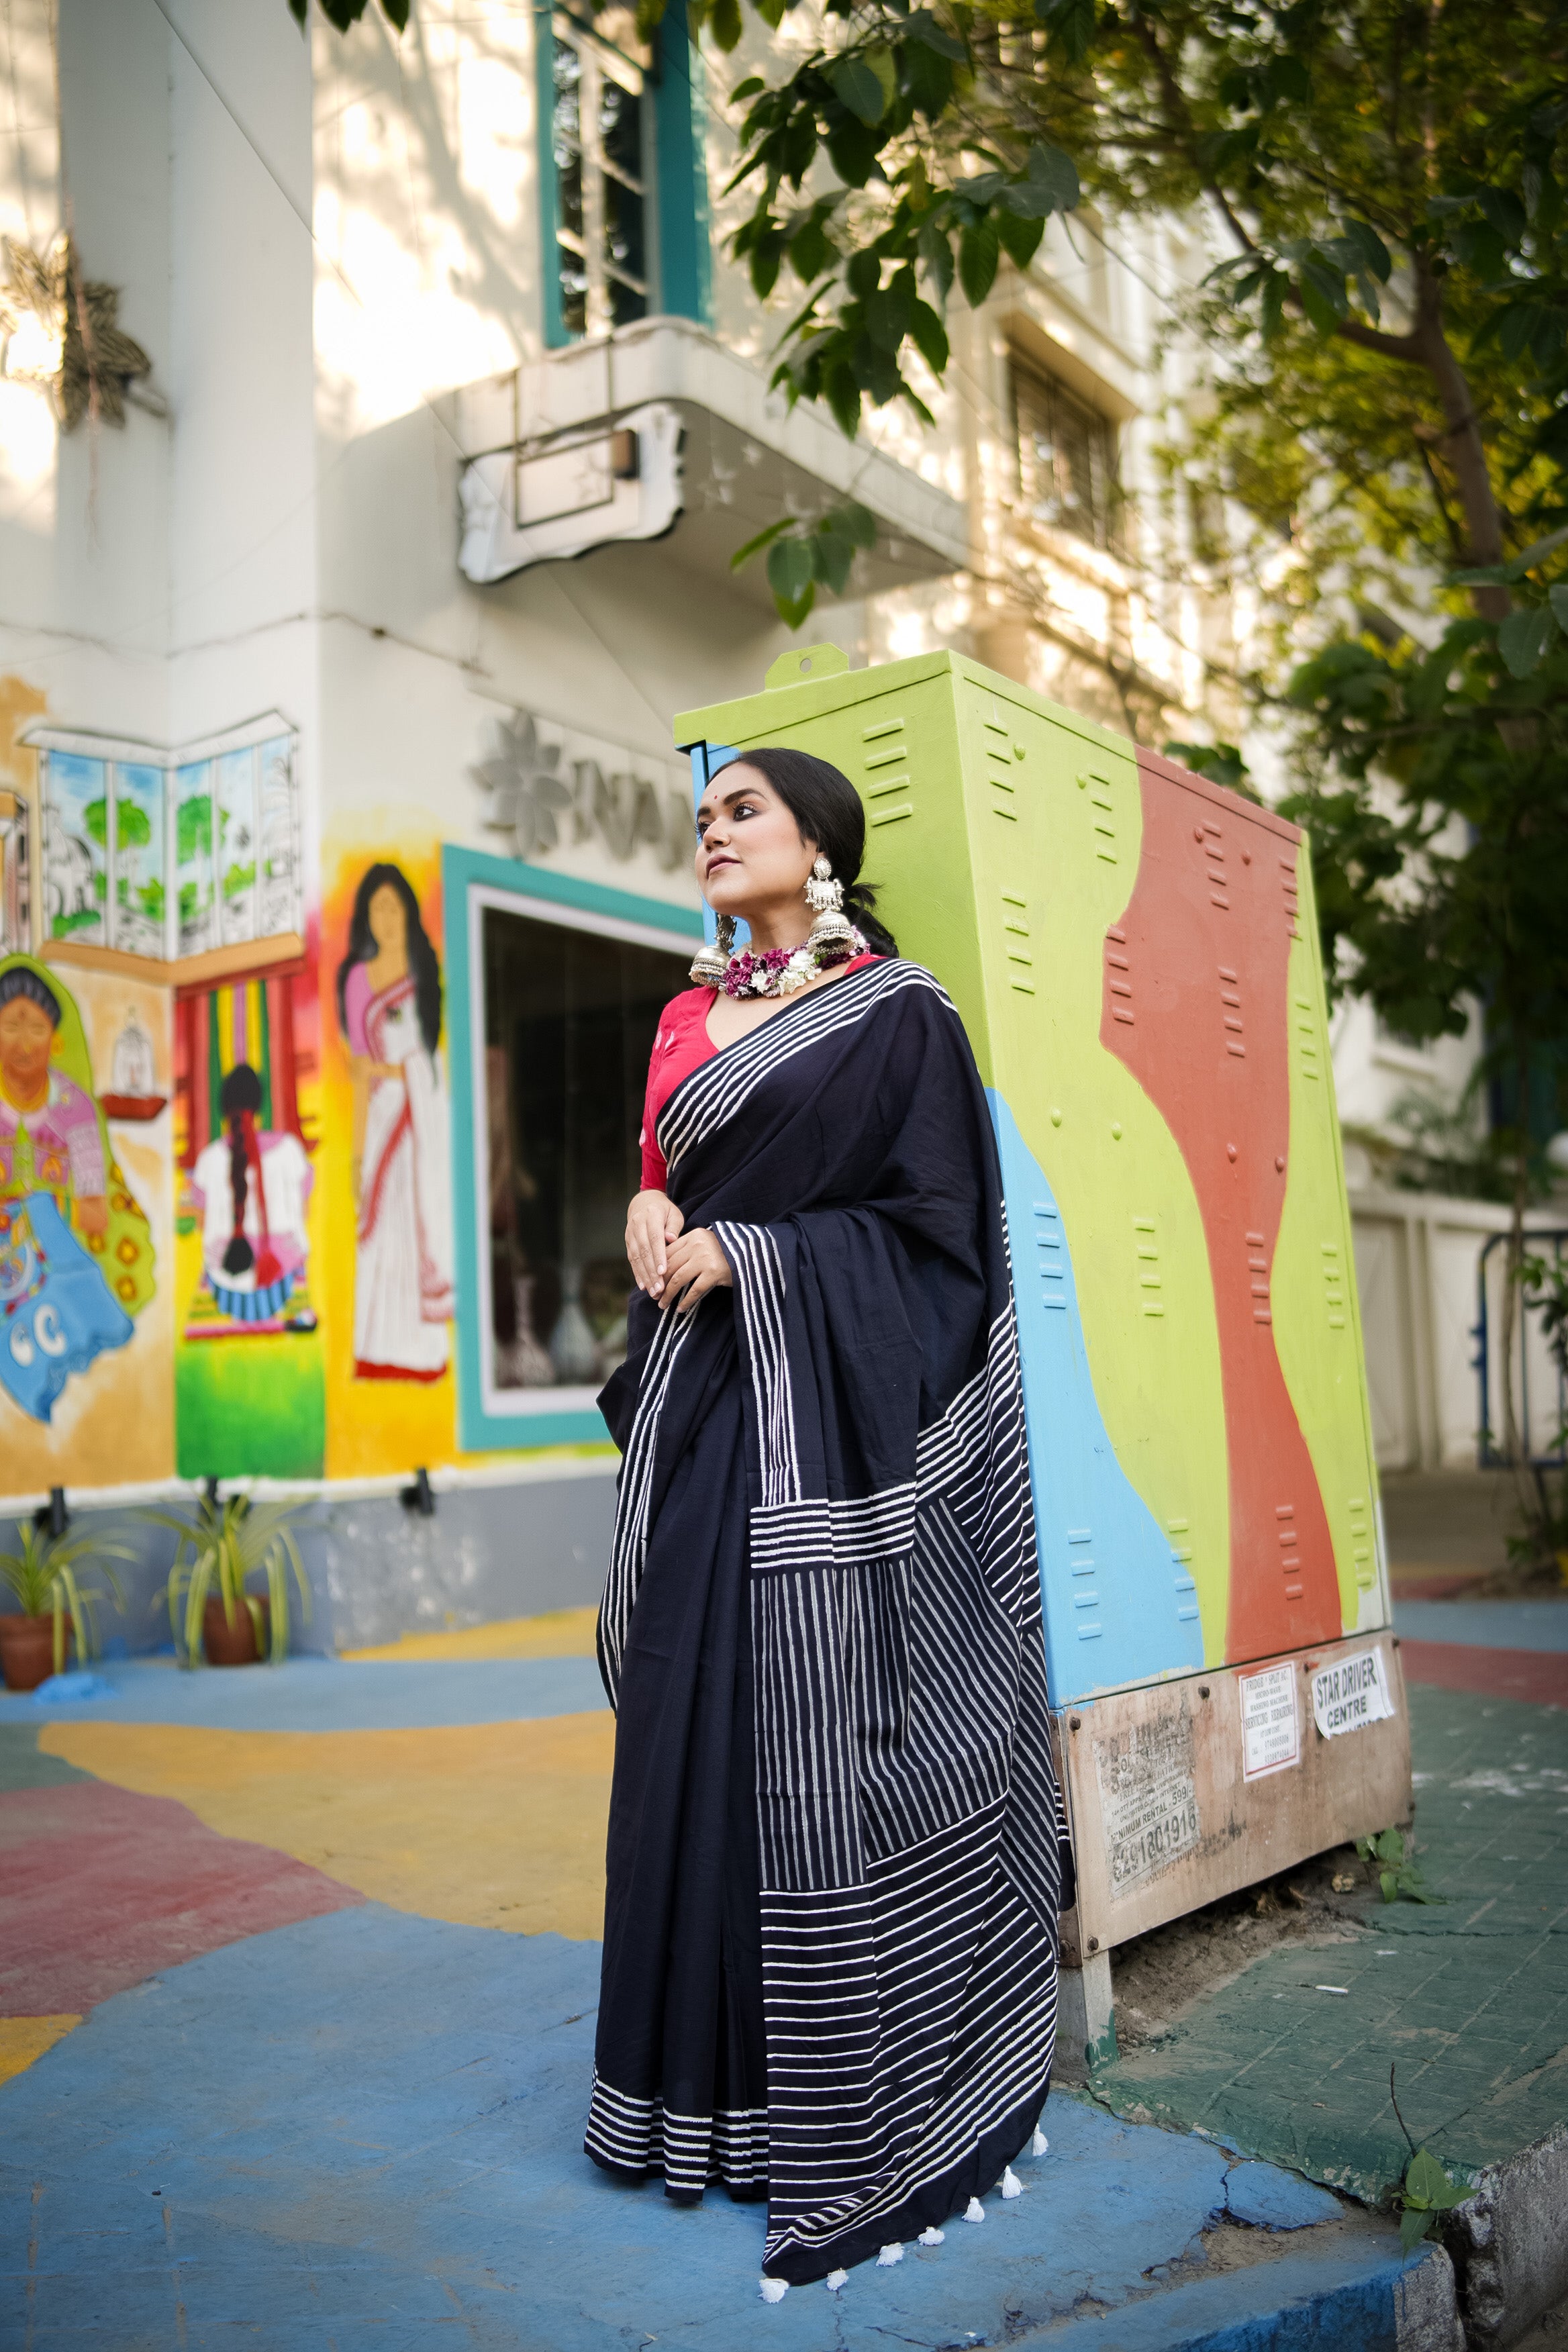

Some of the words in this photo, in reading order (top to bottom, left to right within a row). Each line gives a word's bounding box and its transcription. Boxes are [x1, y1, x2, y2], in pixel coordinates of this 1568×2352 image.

[1246, 1677, 1264, 1692] FRIDGE
[1269, 1671, 1279, 1686] SPLIT
[1317, 1671, 1340, 1710] STAR
[1342, 1657, 1377, 1698] DRIVER
[1250, 1700, 1269, 1713] WASHING
[1270, 1694, 1288, 1707] MACHINE
[1327, 1695, 1367, 1730] CENTRE
[1245, 1712, 1268, 1730] SERVICING
[1271, 1704, 1294, 1721] REPAIRING
[1159, 1781, 1181, 1799] INTERNET
[1111, 1817, 1141, 1844] MNIMUM
[1142, 1802, 1168, 1825] RENTAL
[1172, 1784, 1191, 1806] 599/-
[1120, 1802, 1129, 1813] OTT
[1130, 1795, 1141, 1807] APPS
